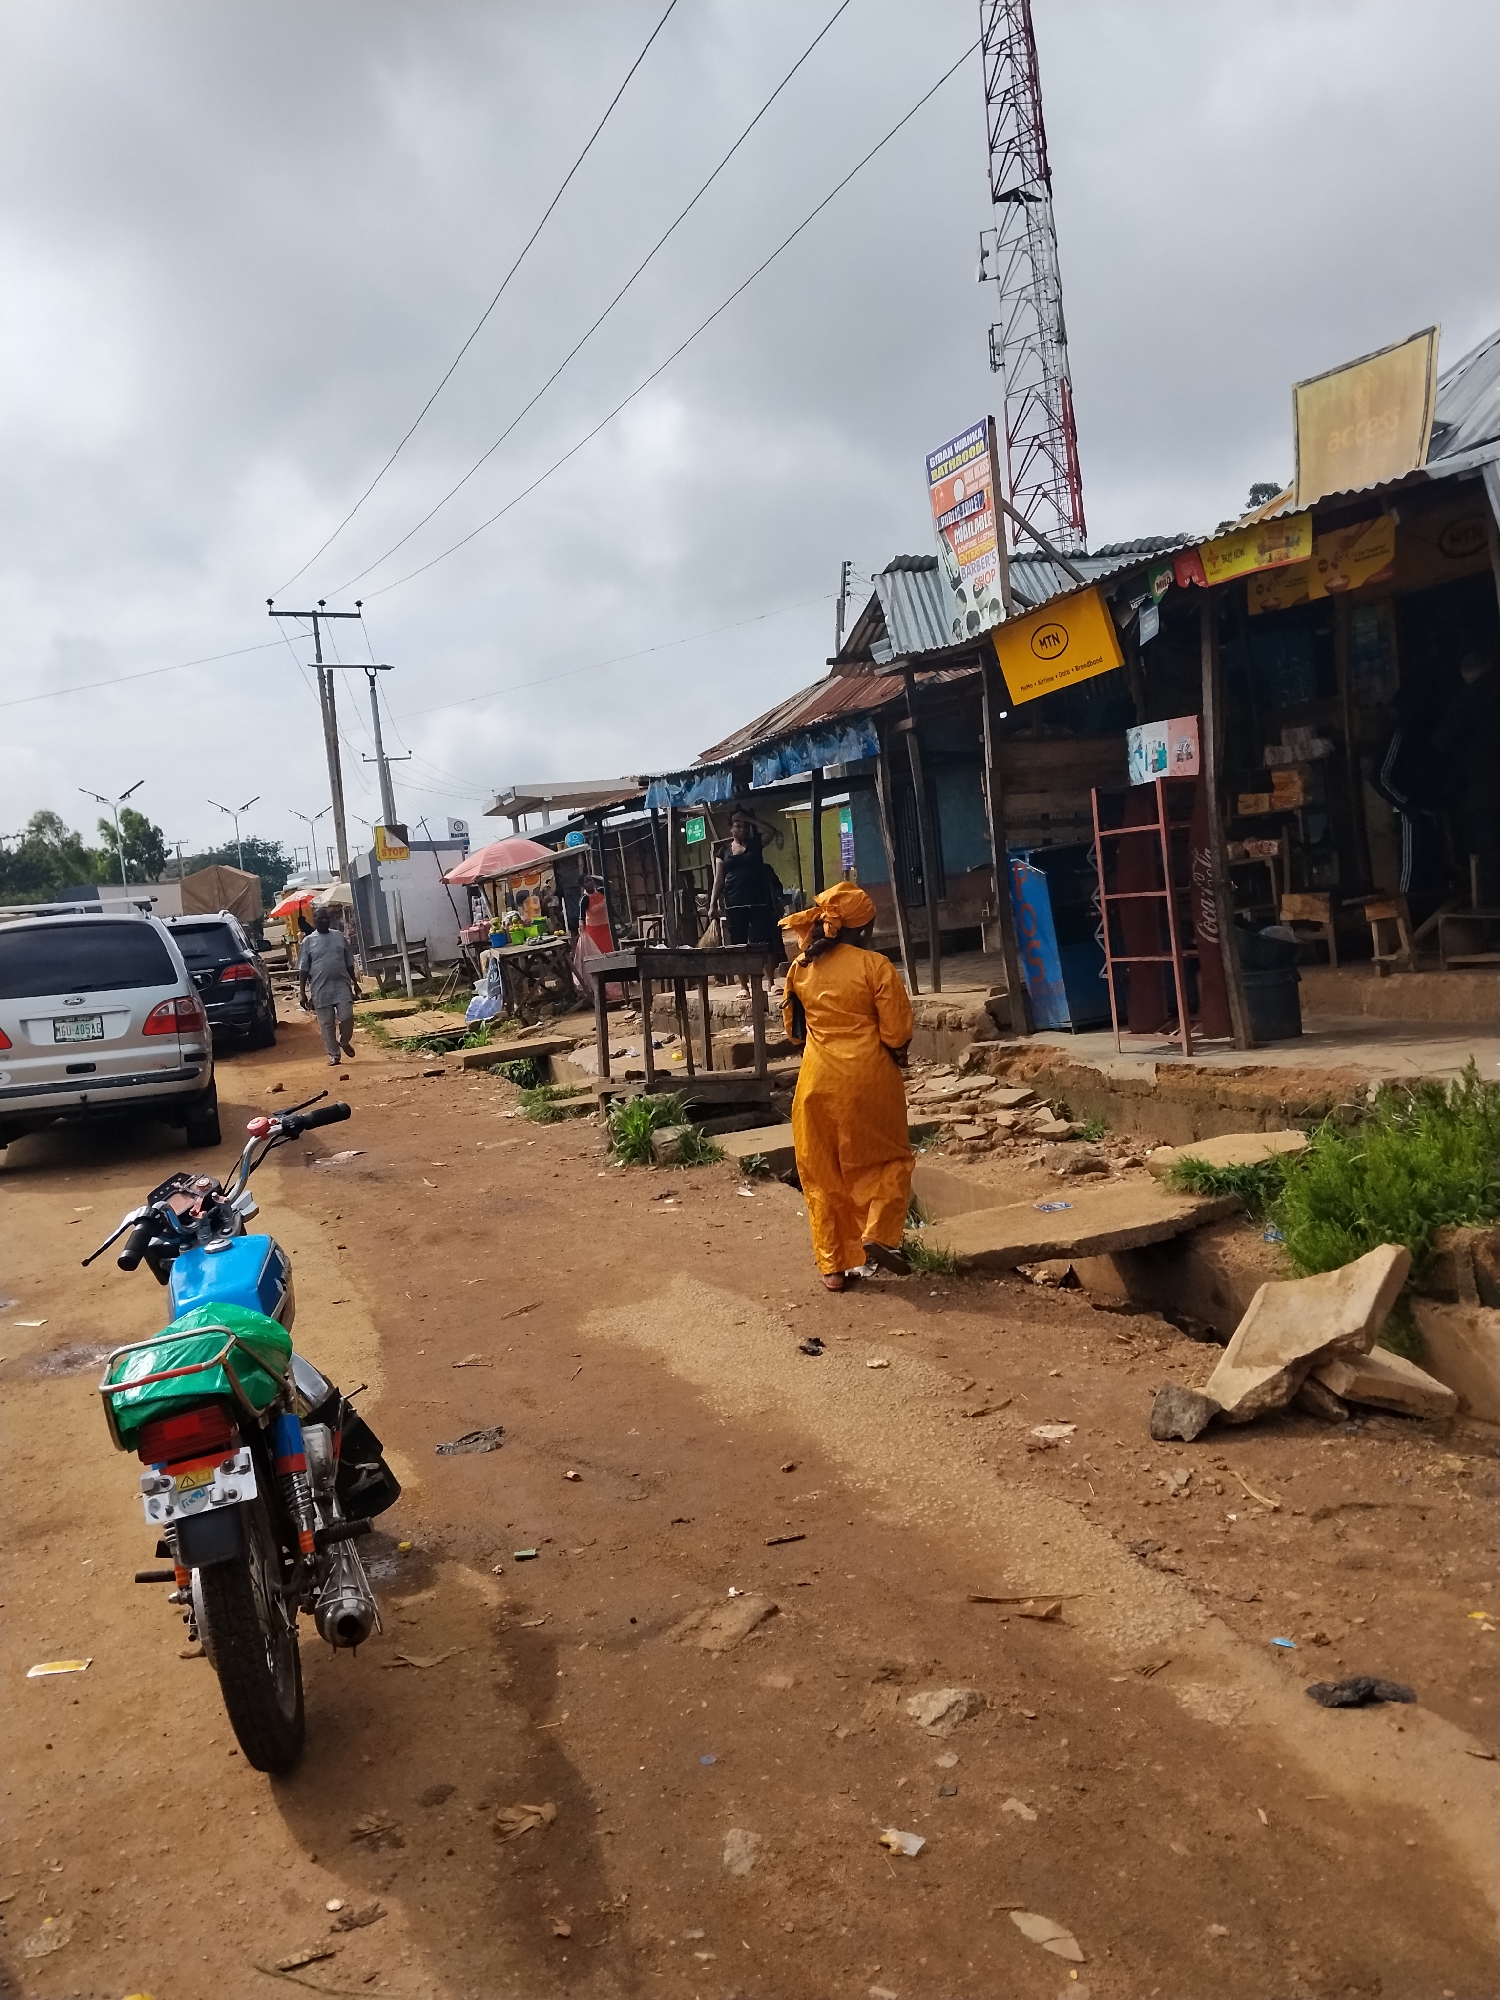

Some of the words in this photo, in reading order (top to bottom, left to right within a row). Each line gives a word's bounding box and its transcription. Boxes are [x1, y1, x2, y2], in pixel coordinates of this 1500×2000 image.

[1327, 406, 1401, 454] access
[960, 550, 997, 581] BARBER'S
[974, 568, 996, 592] SHOP
[1155, 575, 1172, 592] MILO
[1038, 631, 1061, 651] MTN
[1037, 675, 1055, 686] Airtime
[1058, 668, 1071, 679] Data
[1074, 655, 1104, 673] Broadband
[381, 847, 405, 858] STOP
